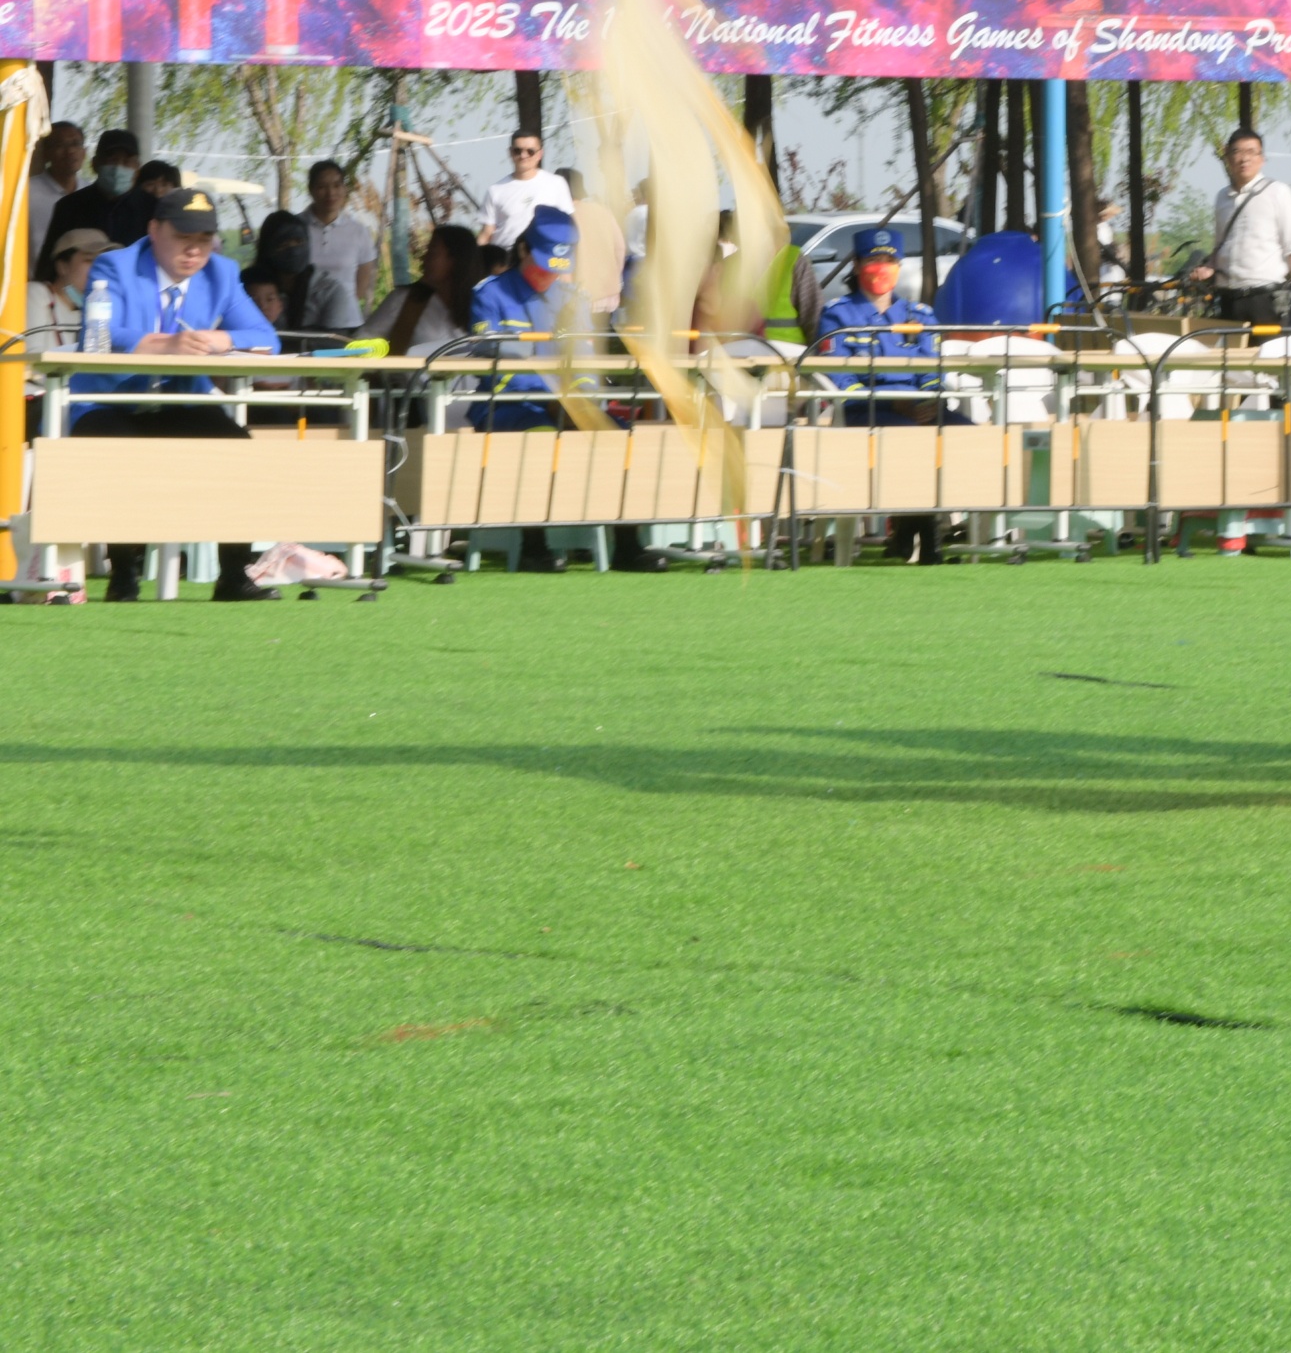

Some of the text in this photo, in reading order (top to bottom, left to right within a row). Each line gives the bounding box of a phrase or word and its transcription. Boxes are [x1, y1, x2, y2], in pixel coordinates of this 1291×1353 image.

[424, 1, 521, 37] 2023
[530, 1, 592, 41] The
[680, 5, 818, 45] National
[824, 10, 936, 53] Fitness
[946, 11, 1044, 61] Games
[1051, 17, 1084, 63] of
[1091, 16, 1237, 64] Shandong
